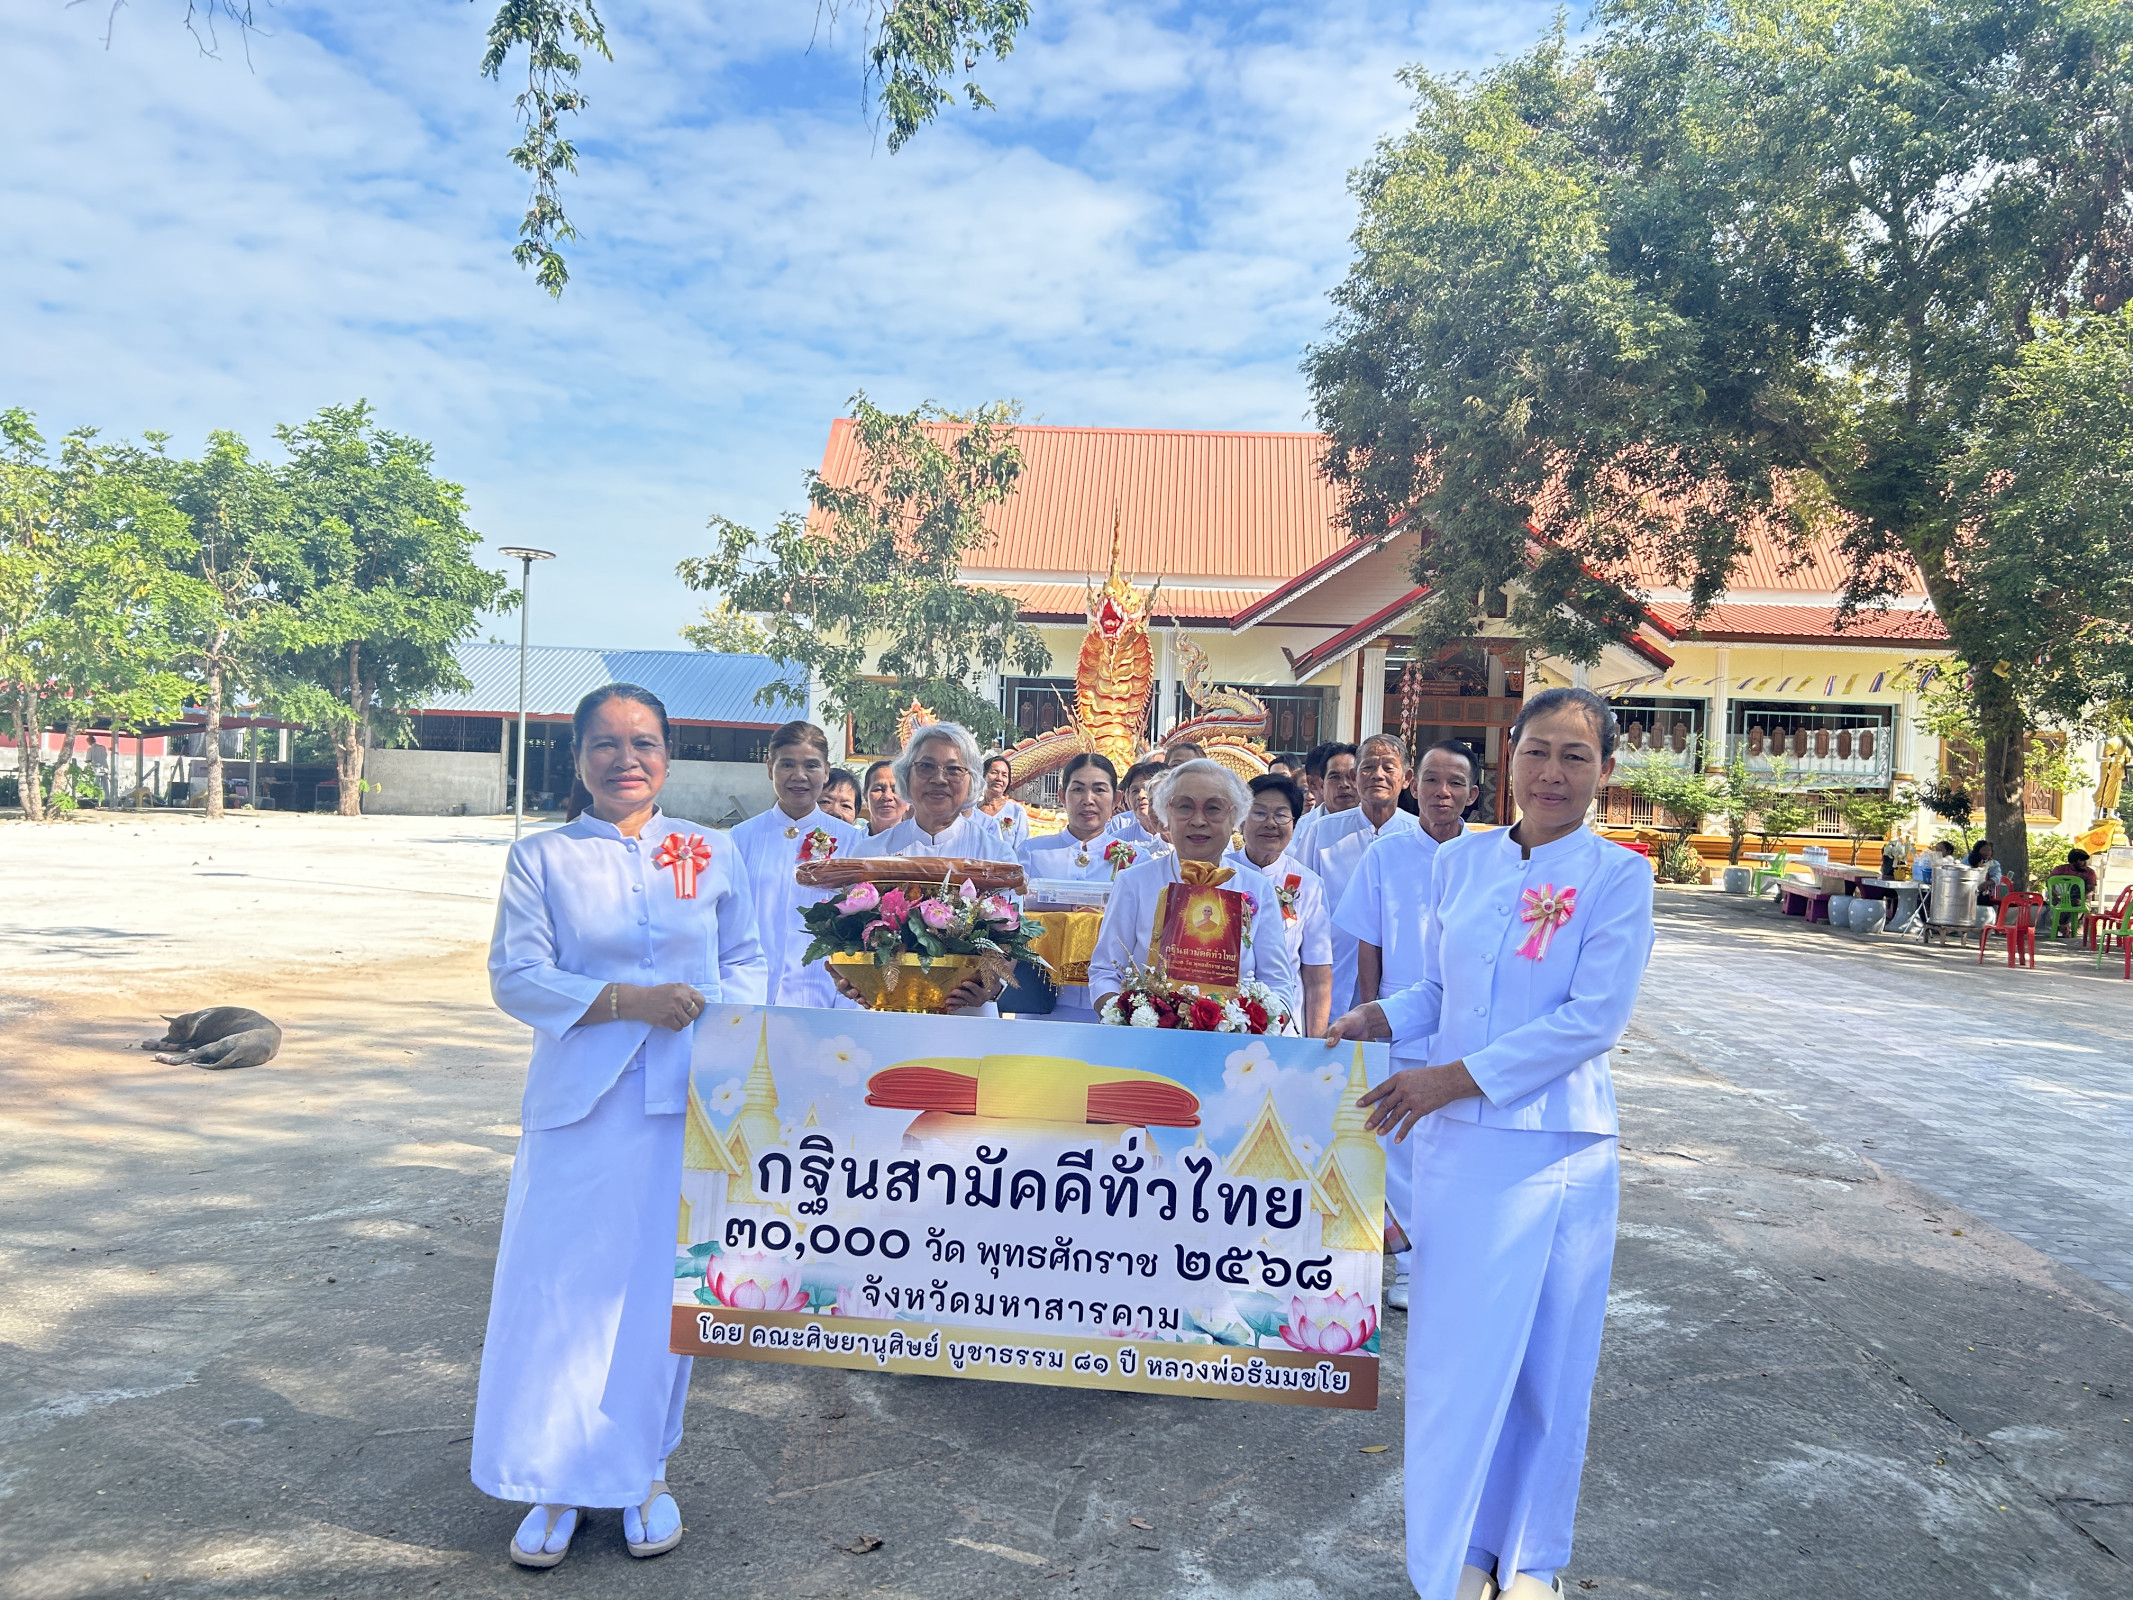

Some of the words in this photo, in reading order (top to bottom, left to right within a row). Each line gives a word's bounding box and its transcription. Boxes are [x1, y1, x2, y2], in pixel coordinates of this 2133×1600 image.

[757, 1134, 1303, 1231] กฐินสามัคคีทั่วไทย
[725, 1218, 911, 1260] ๓๐,๐๐๐
[925, 1226, 966, 1265] วัด
[976, 1235, 1159, 1281] พุทธศักราช
[1174, 1243, 1334, 1292] ๒๕๖๘
[861, 1274, 1180, 1330] จังหวัดมหาสารคาม
[698, 1315, 743, 1345] โดย
[752, 1325, 940, 1364] คณะศิษยานุศิษย์
[949, 1343, 1065, 1370] บูชาธรรม
[1074, 1354, 1109, 1375] ๘๑
[1119, 1347, 1137, 1375] ปี
[1147, 1359, 1348, 1392] หลวงพ่อธัมมชโย
